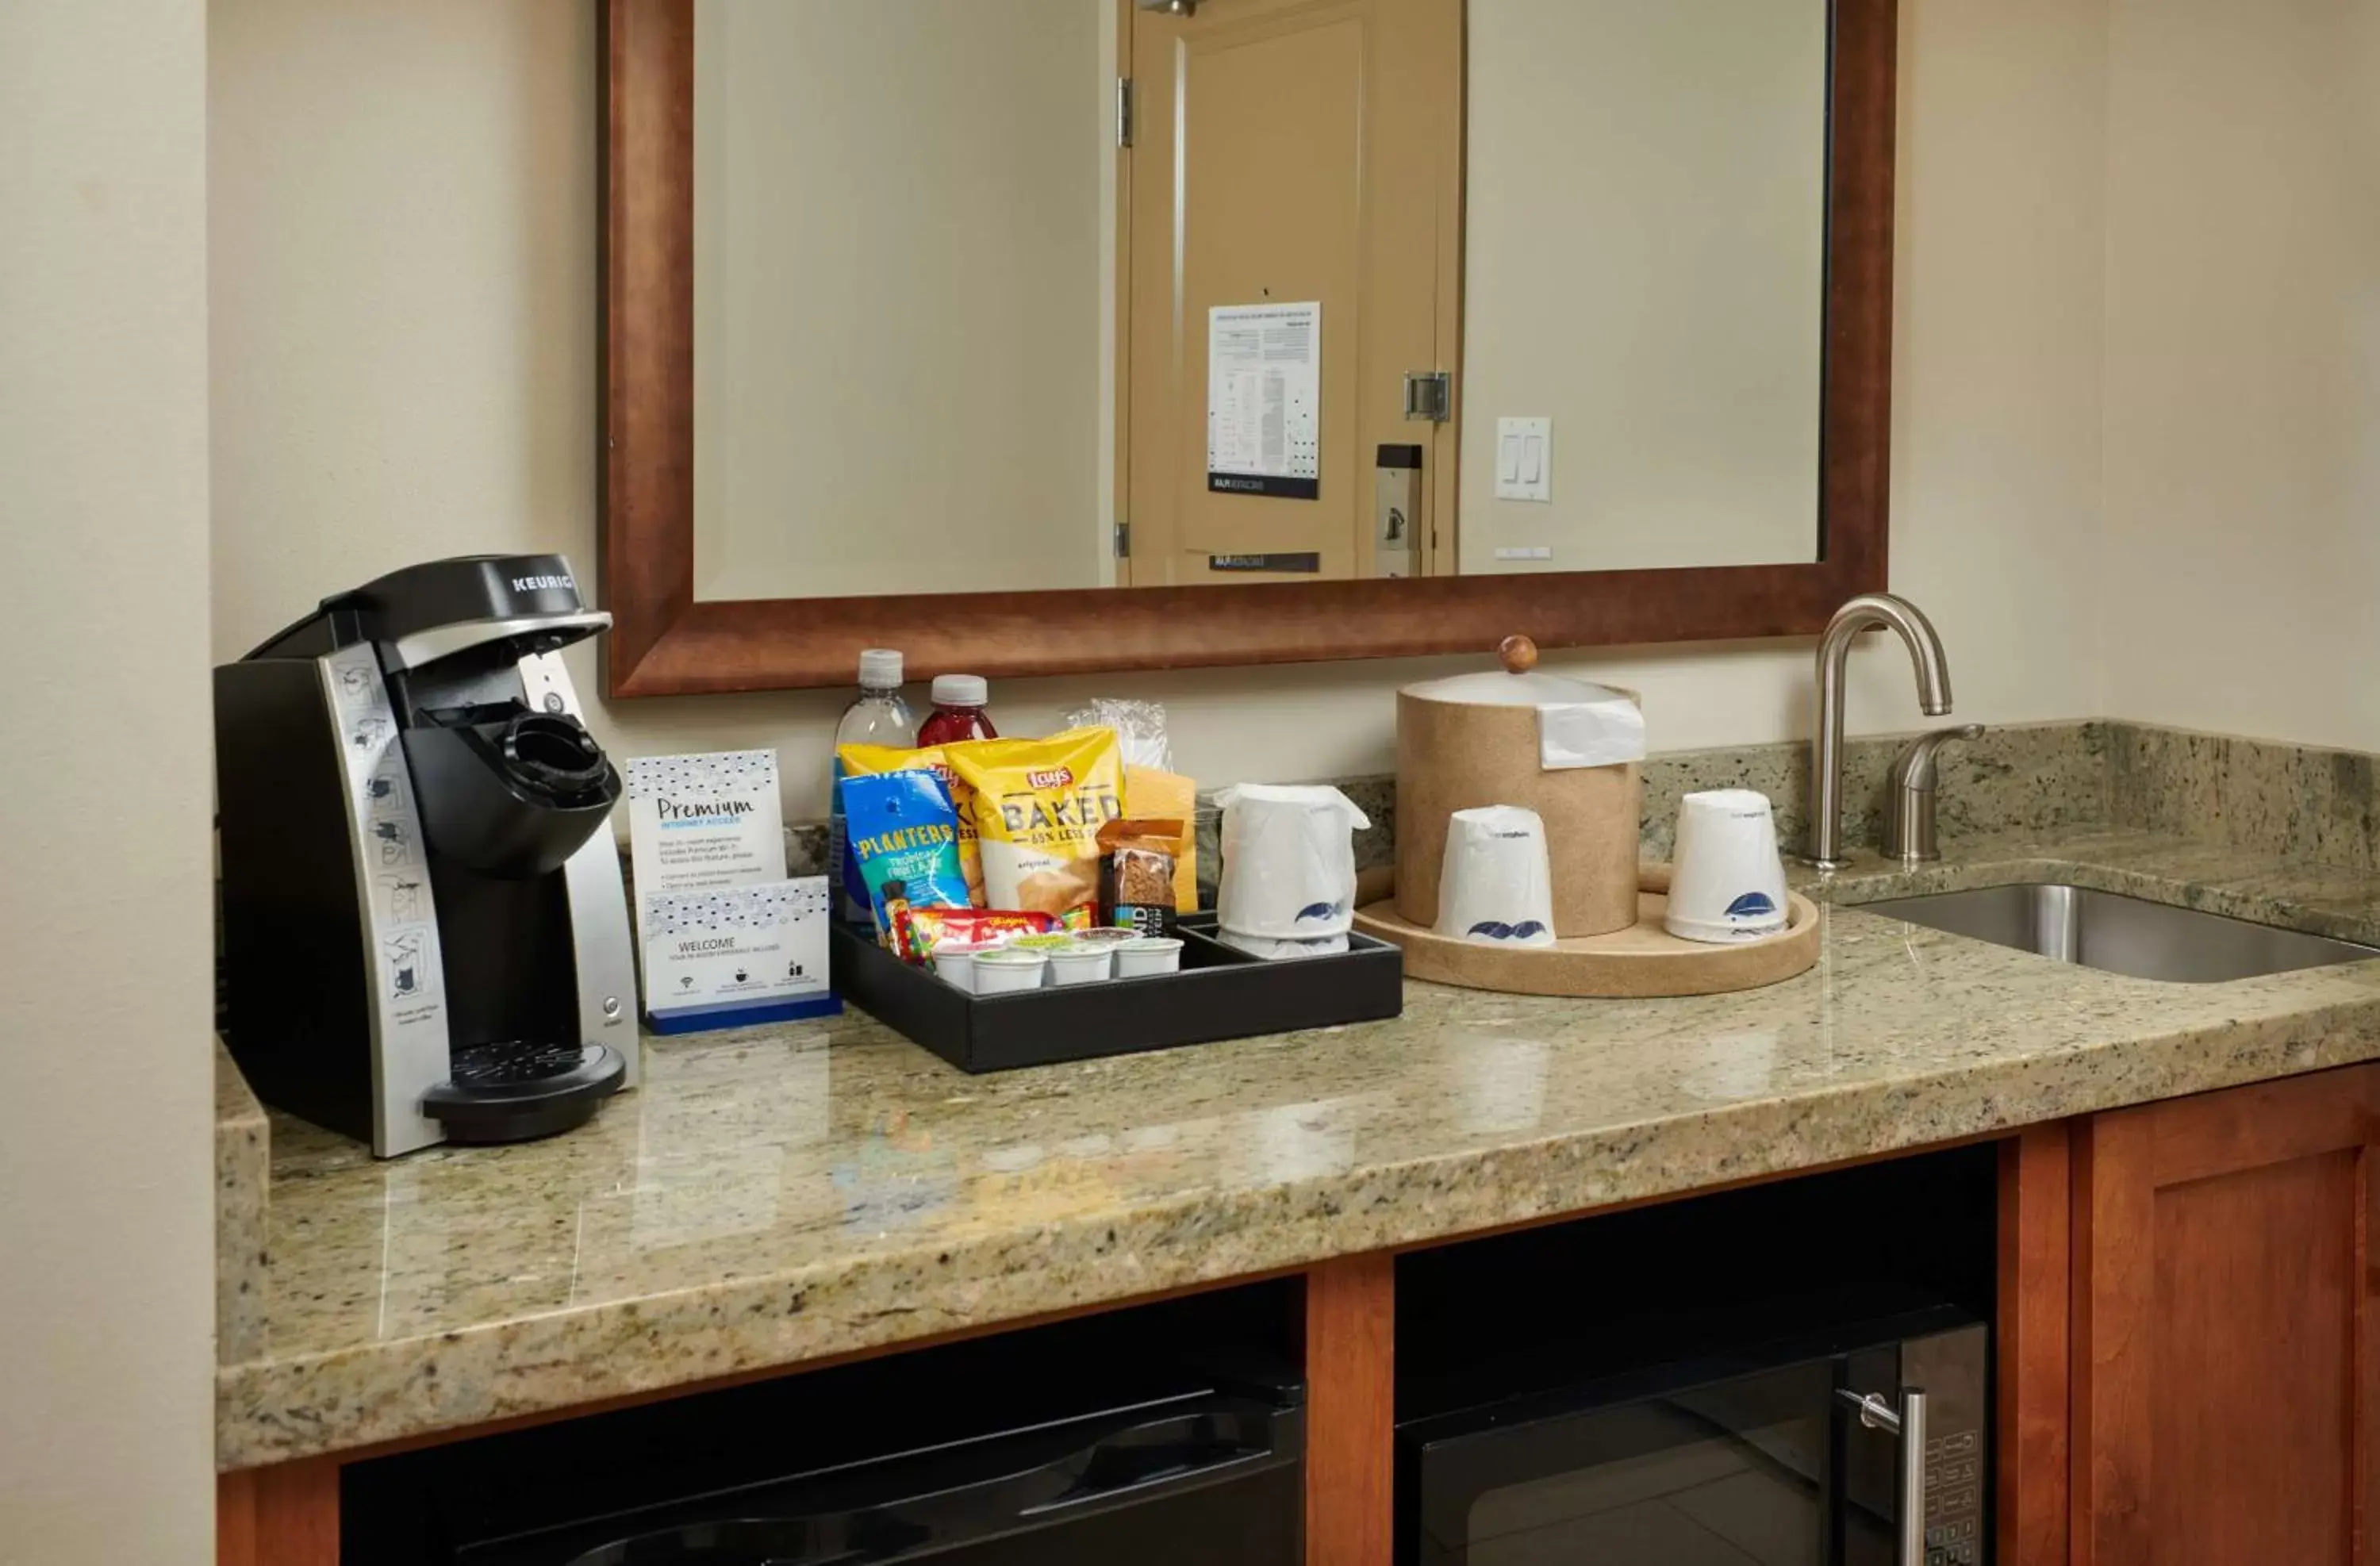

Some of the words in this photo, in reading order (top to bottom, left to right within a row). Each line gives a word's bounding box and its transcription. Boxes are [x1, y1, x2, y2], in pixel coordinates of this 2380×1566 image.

[512, 575, 573, 592] KEURIG
[1031, 769, 1069, 788] Lay's
[658, 797, 755, 819] Premium
[1001, 795, 1123, 831] BAKED
[858, 823, 954, 860] PLANTERS
[678, 936, 735, 952] WELCOME
